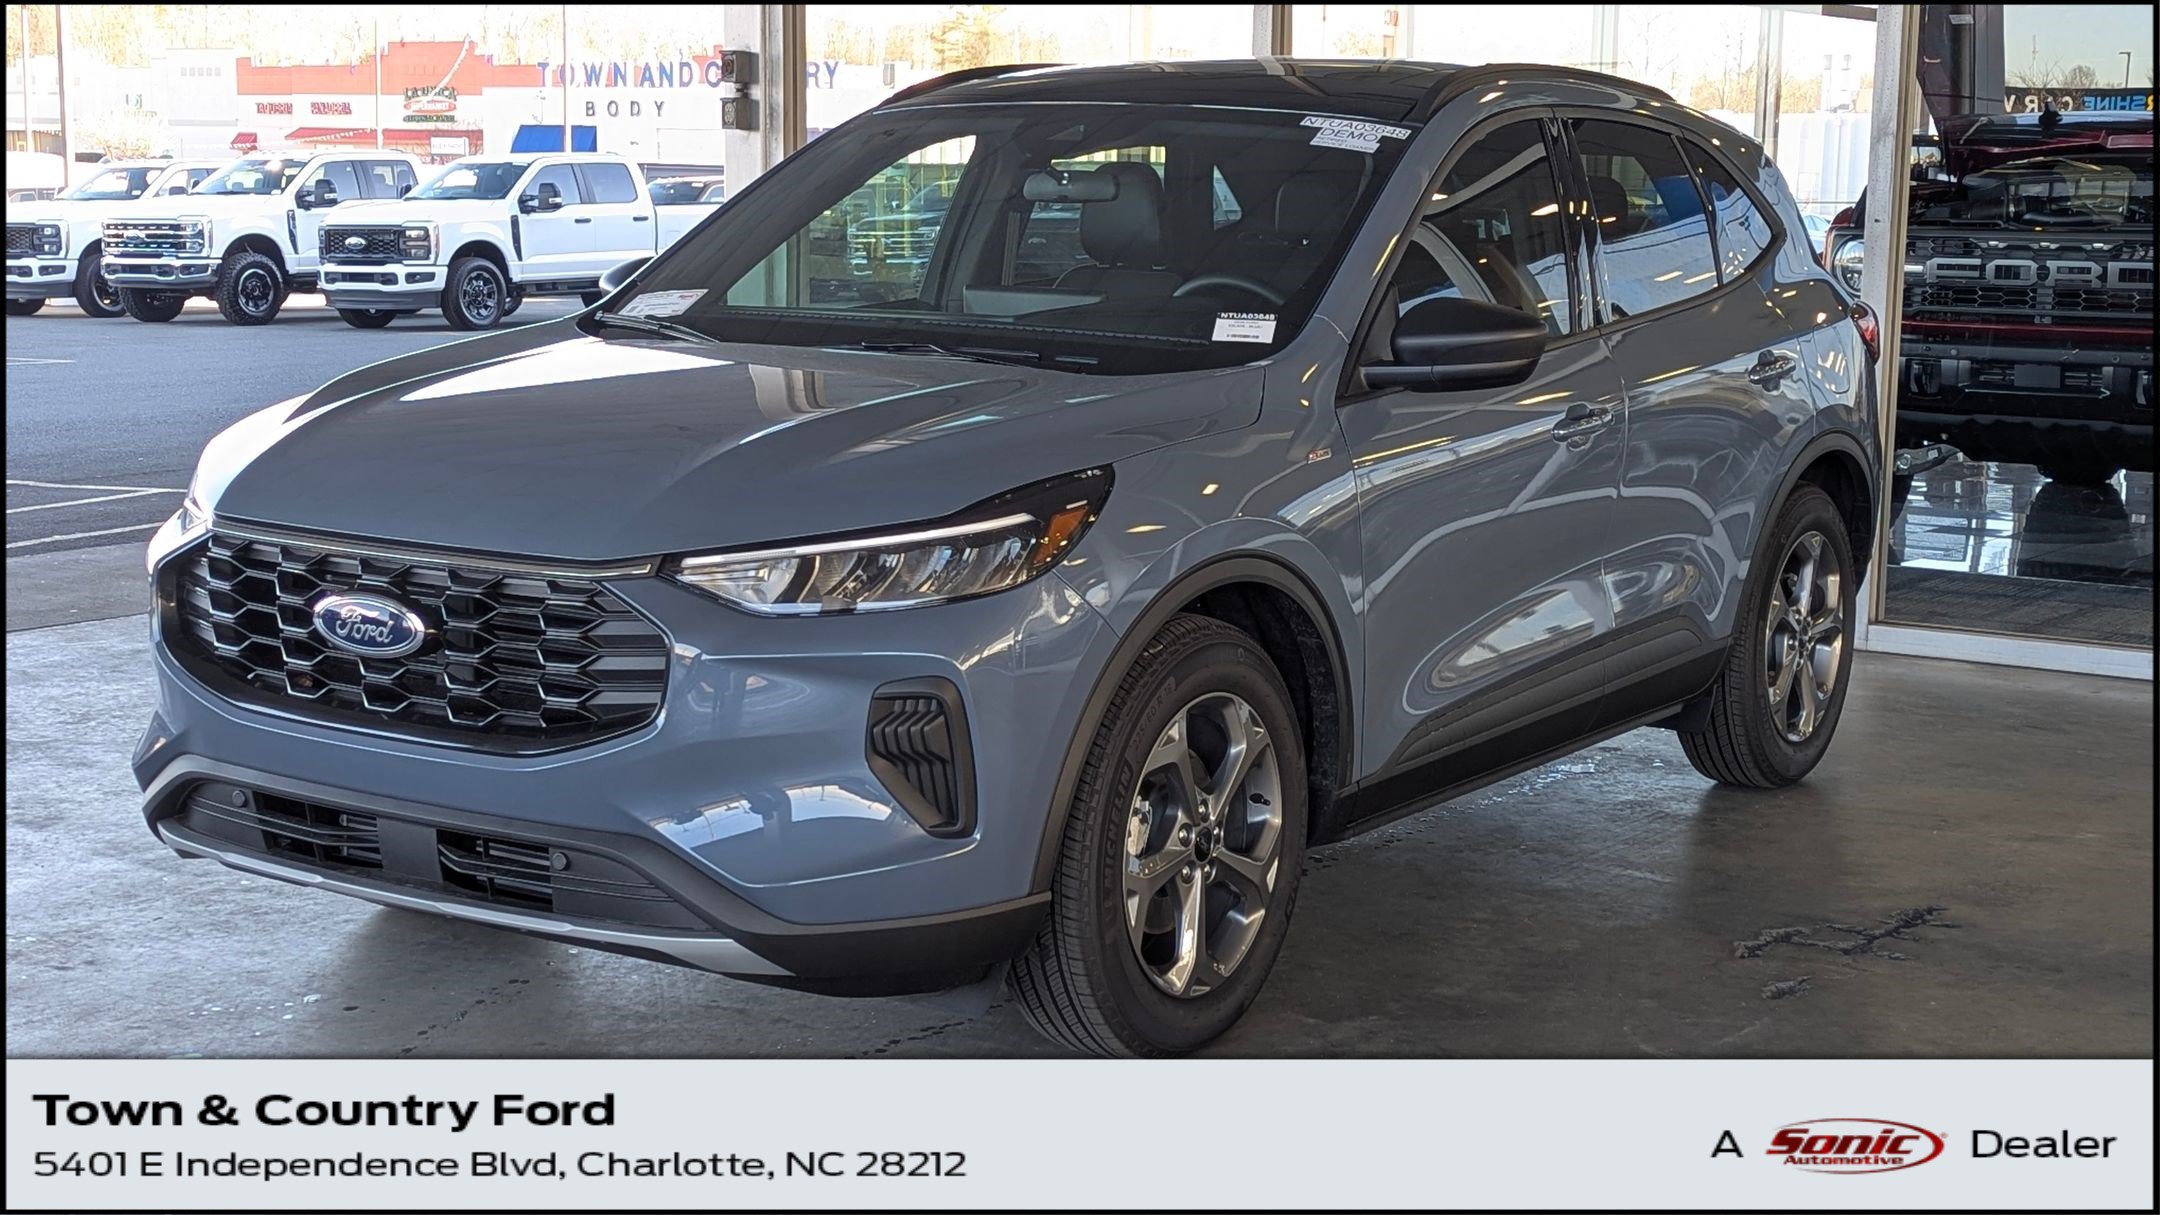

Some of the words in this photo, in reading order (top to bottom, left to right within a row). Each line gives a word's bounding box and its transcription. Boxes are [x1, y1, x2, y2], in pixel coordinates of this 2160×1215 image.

[537, 61, 628, 88] TOWN
[639, 61, 694, 88] AND
[585, 101, 665, 118] BODY
[1303, 117, 1408, 137] NTUA03648
[1320, 129, 1378, 143] DEMO
[335, 605, 395, 643] Ford
